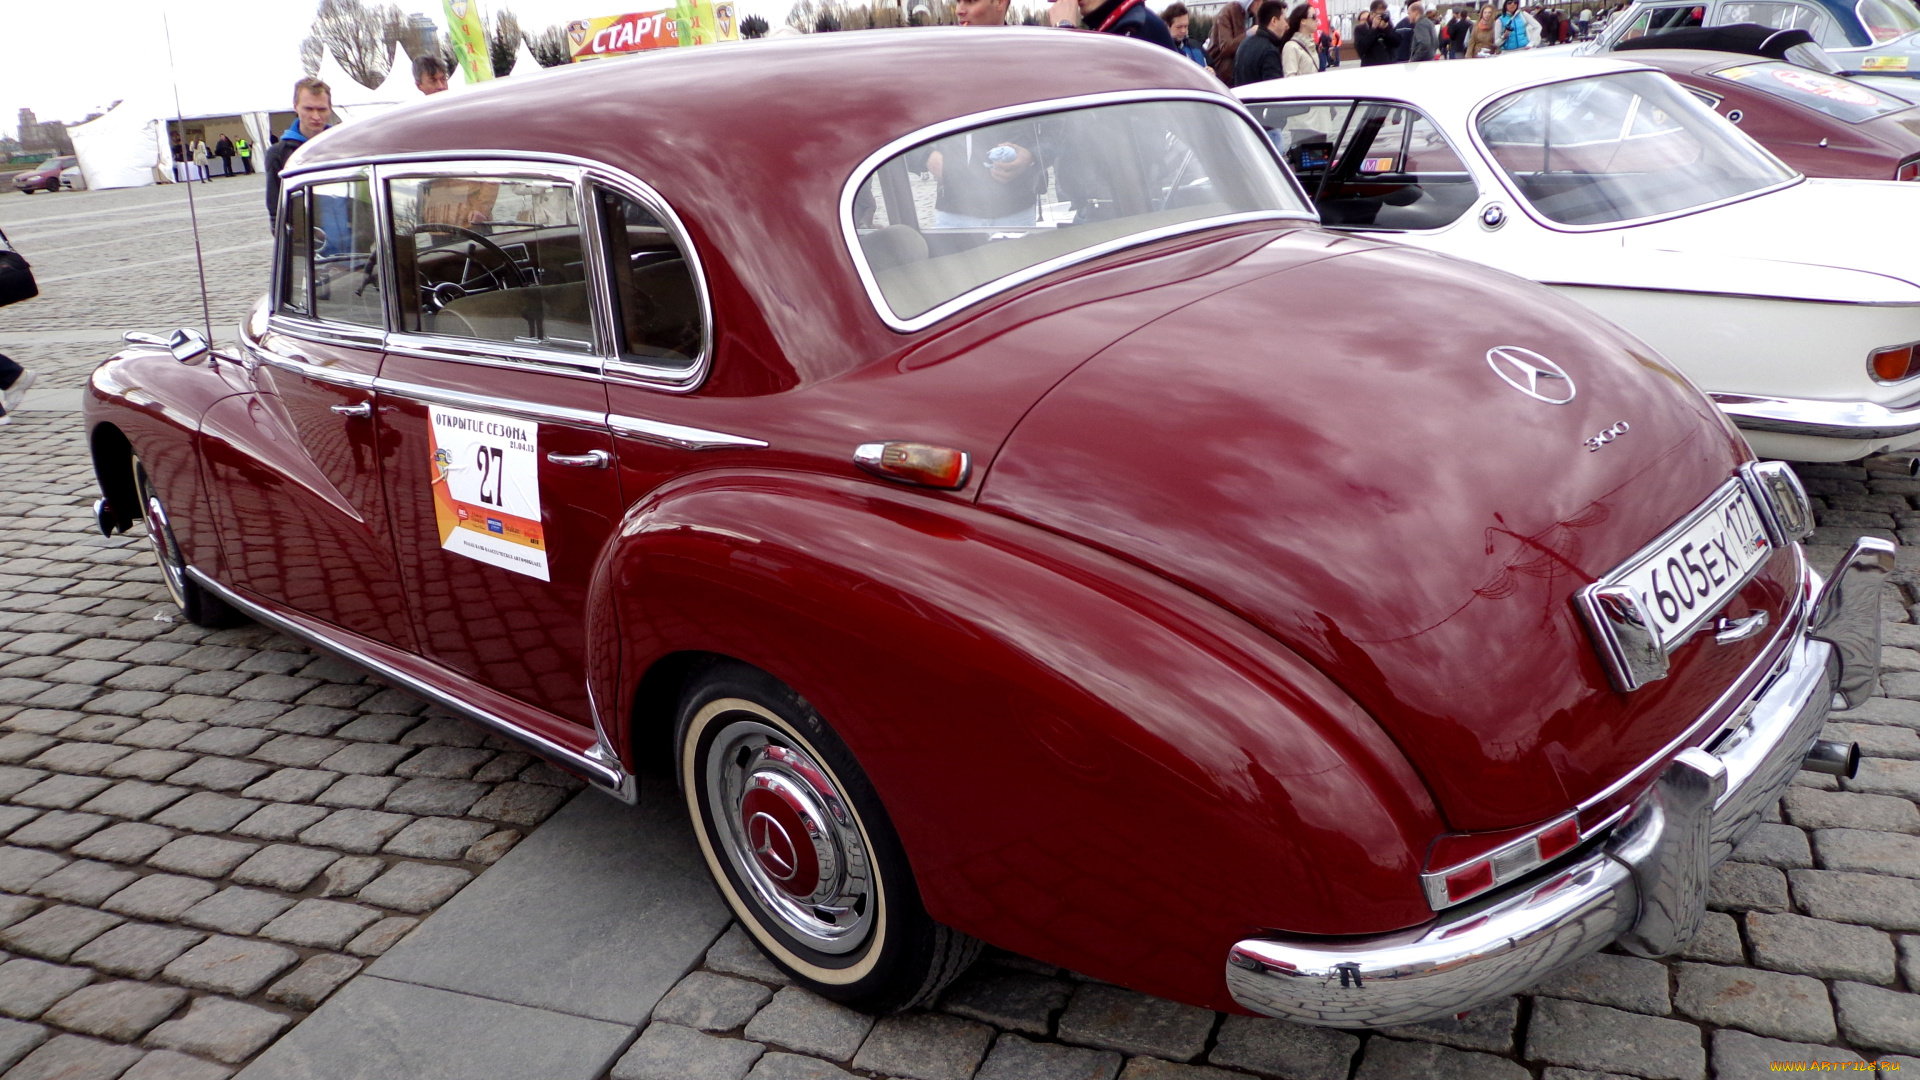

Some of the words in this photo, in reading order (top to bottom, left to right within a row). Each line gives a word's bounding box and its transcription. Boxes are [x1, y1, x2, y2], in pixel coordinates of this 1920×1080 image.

[592, 12, 666, 54] СТАРТ
[436, 414, 484, 433] ОТКРЫТИЕ
[487, 423, 527, 441] СЕЗОНА
[1584, 420, 1630, 452] 300
[477, 445, 503, 507] 27
[1724, 493, 1756, 545] 177
[1743, 538, 1757, 559] RUS
